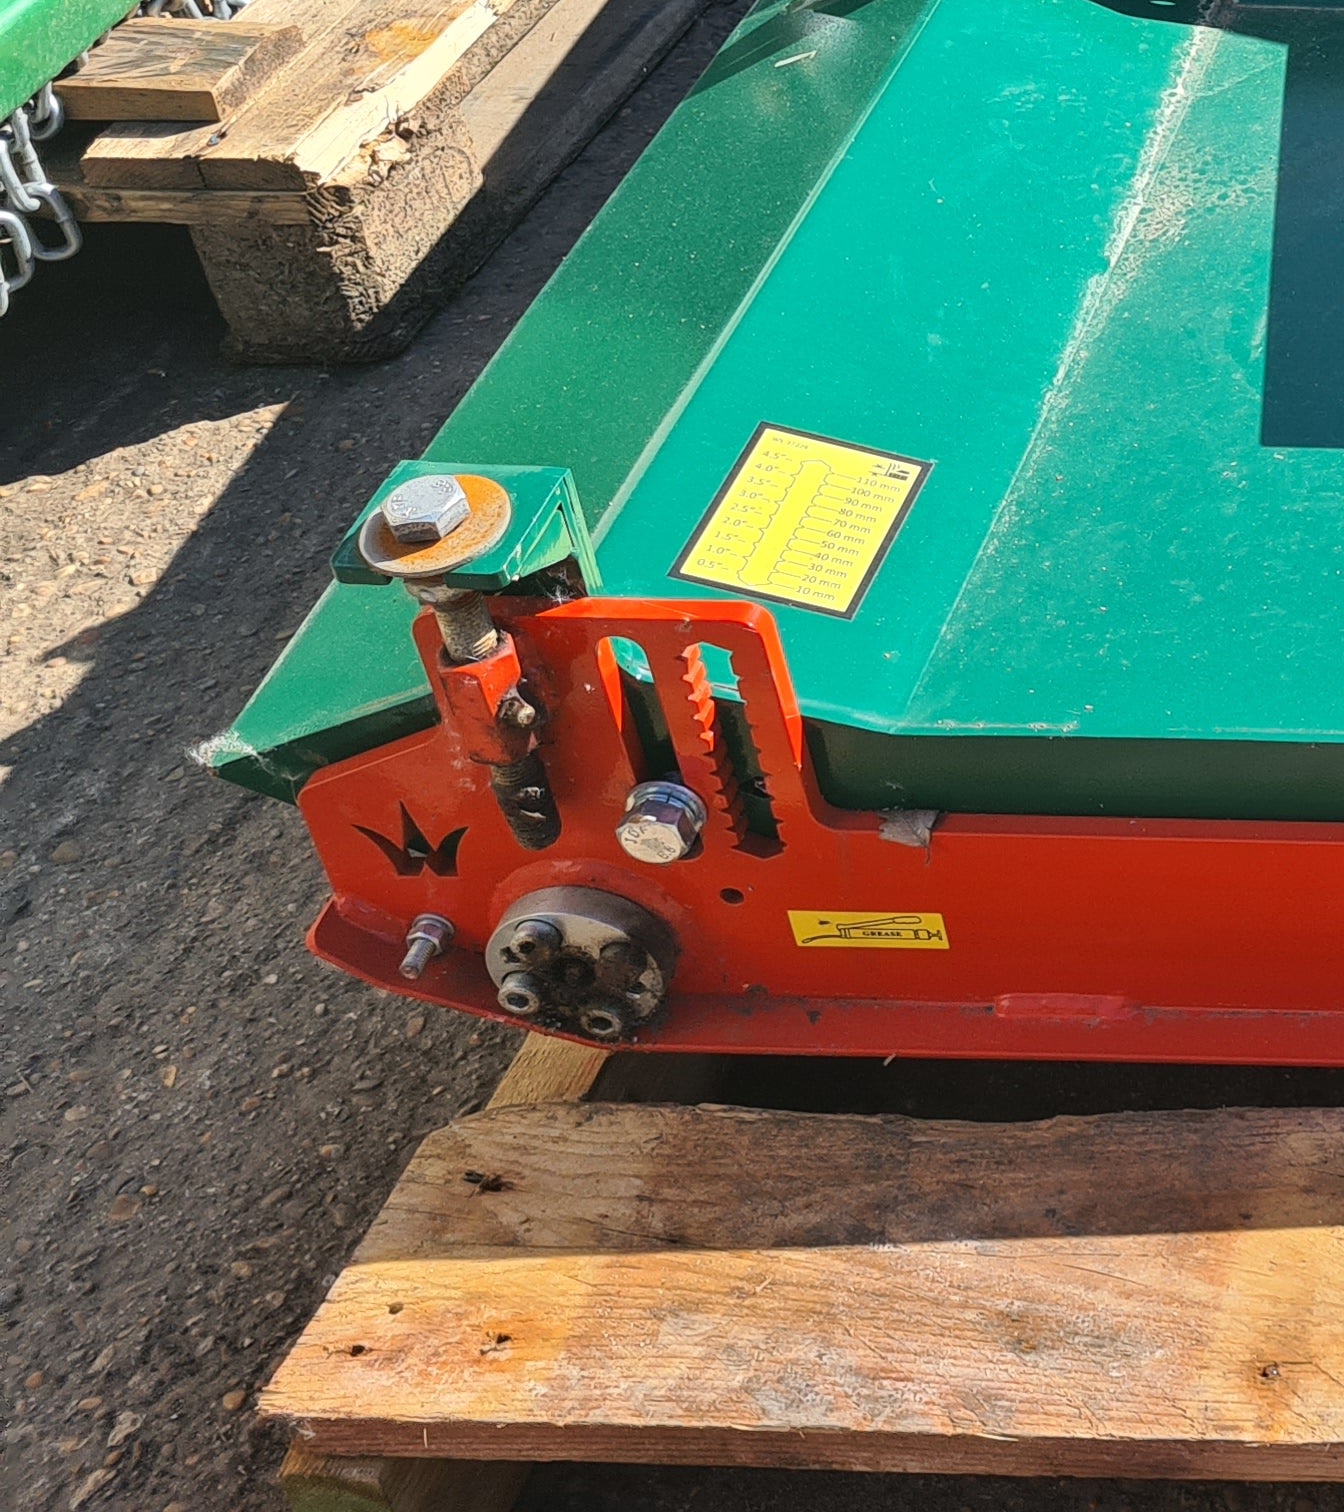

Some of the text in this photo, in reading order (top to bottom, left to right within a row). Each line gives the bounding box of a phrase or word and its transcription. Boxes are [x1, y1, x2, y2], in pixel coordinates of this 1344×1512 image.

[858, 477, 900, 492] 110 mm
[851, 488, 894, 502] 100 mm
[844, 498, 882, 512] 90 mm
[838, 508, 876, 523] 80 mm
[833, 518, 870, 534] 70 mm
[826, 530, 865, 544] 60 mm
[818, 540, 859, 556] 50 mm
[815, 552, 854, 567] 40 mm
[808, 563, 847, 578] 30 mm
[802, 574, 841, 590] 20 mm
[796, 586, 835, 601] 10 mm
